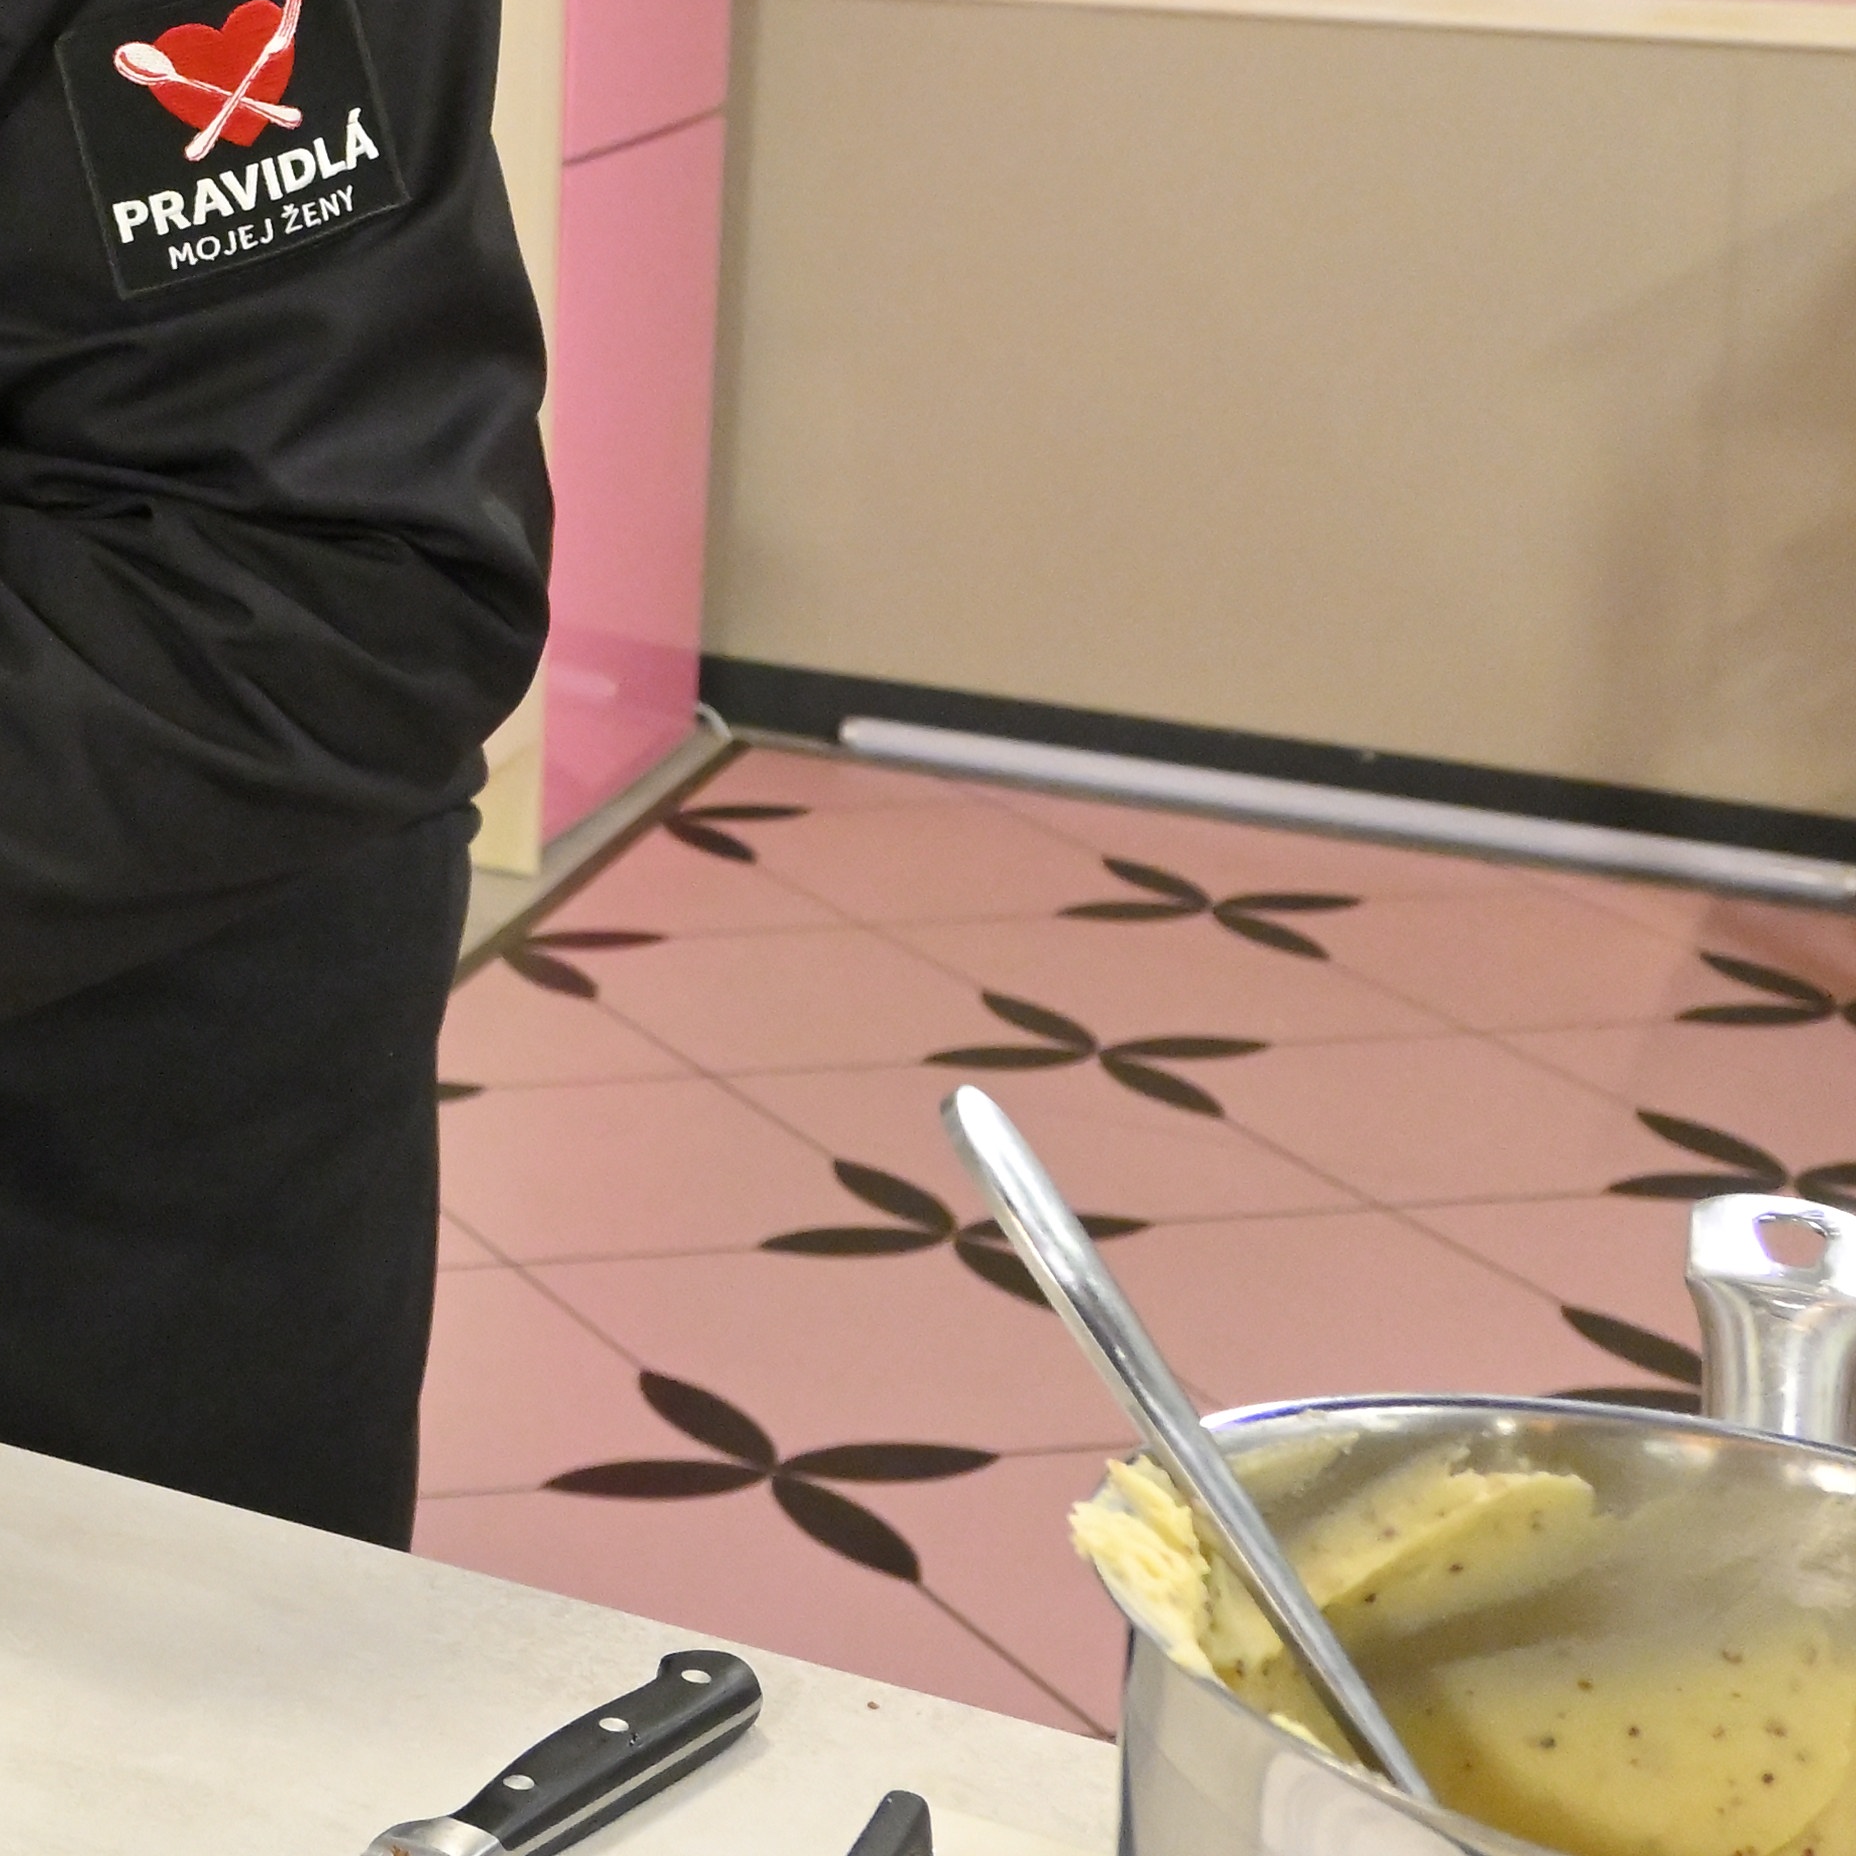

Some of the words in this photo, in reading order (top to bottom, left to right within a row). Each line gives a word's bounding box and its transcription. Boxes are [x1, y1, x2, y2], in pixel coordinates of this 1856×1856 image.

[112, 107, 379, 244] PRAVIDLÁ
[168, 218, 273, 270] MOJEJ
[282, 185, 355, 234] ŽENY
